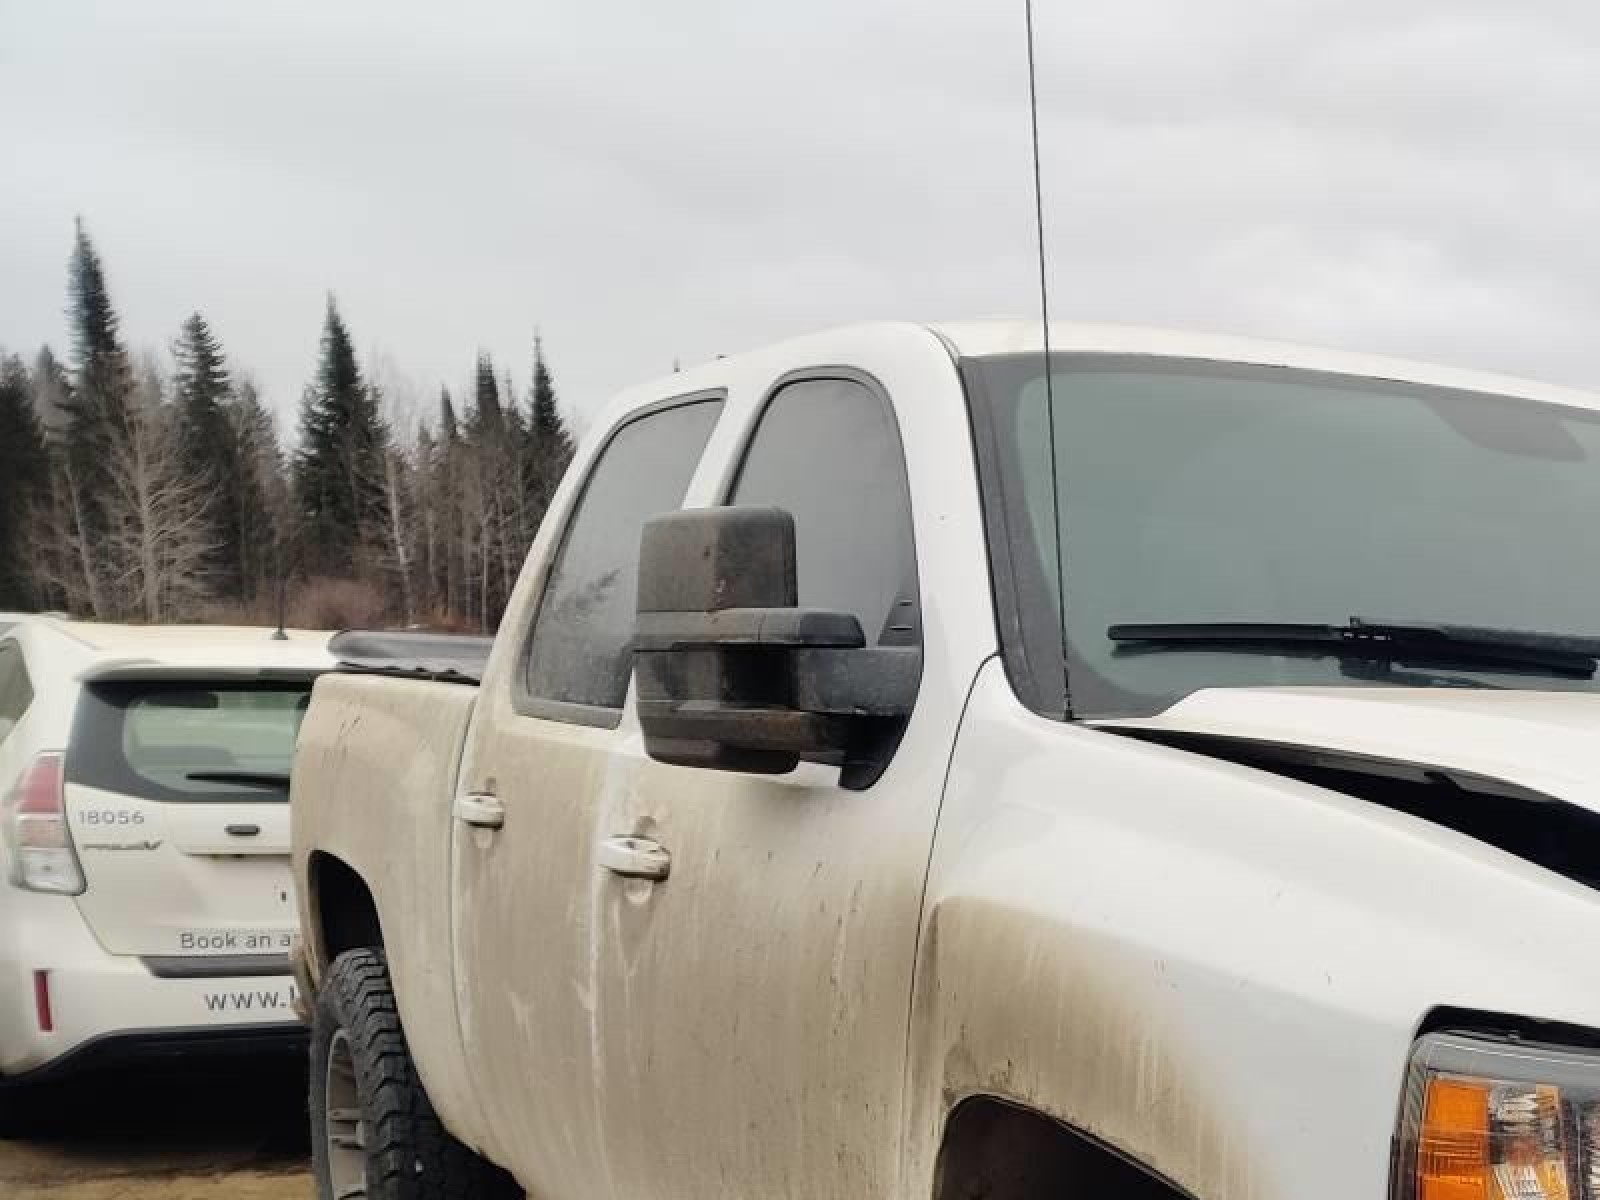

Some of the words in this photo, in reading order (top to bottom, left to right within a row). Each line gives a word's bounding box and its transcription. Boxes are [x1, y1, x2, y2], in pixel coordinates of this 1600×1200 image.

[79, 809, 145, 825] 18056
[180, 931, 237, 949] Book
[246, 934, 271, 948] an
